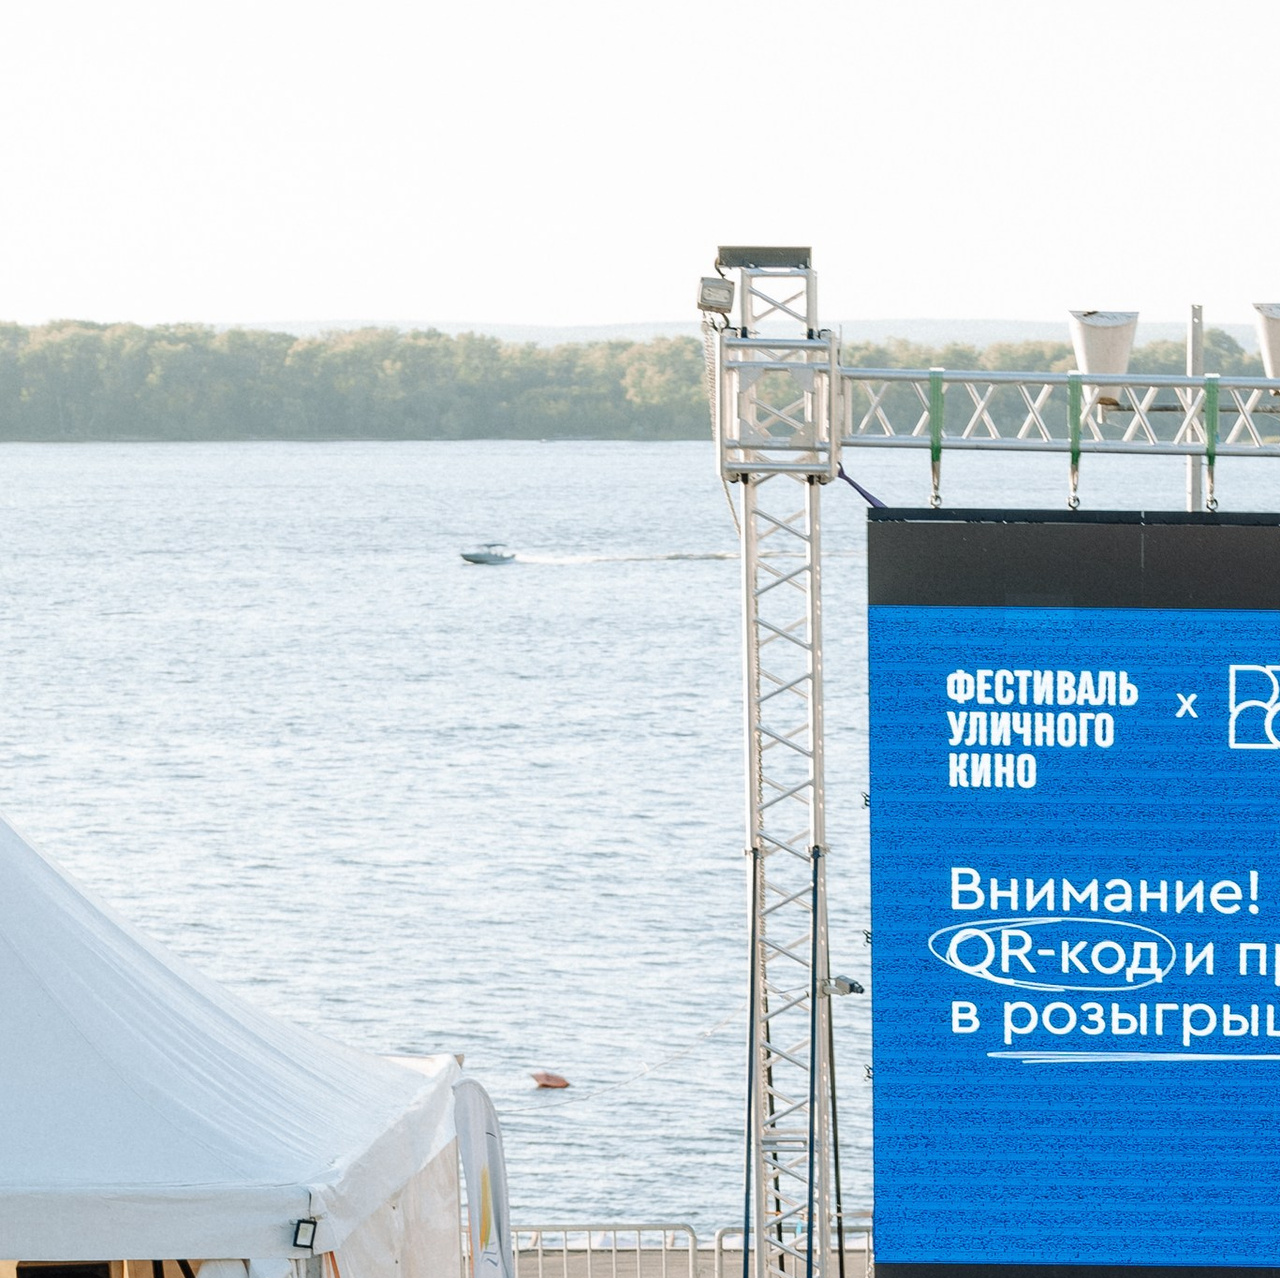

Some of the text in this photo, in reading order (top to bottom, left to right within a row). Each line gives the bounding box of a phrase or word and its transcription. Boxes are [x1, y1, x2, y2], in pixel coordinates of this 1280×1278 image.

[946, 669, 1139, 706] ФЕСТИВАЛЬ
[946, 711, 1115, 747] УЛИЧНОГО
[949, 752, 1037, 789] КИНО
[951, 867, 1259, 915] Внимание!
[948, 928, 1164, 984] QR-код
[1185, 942, 1214, 976] и
[951, 1000, 980, 1034] в
